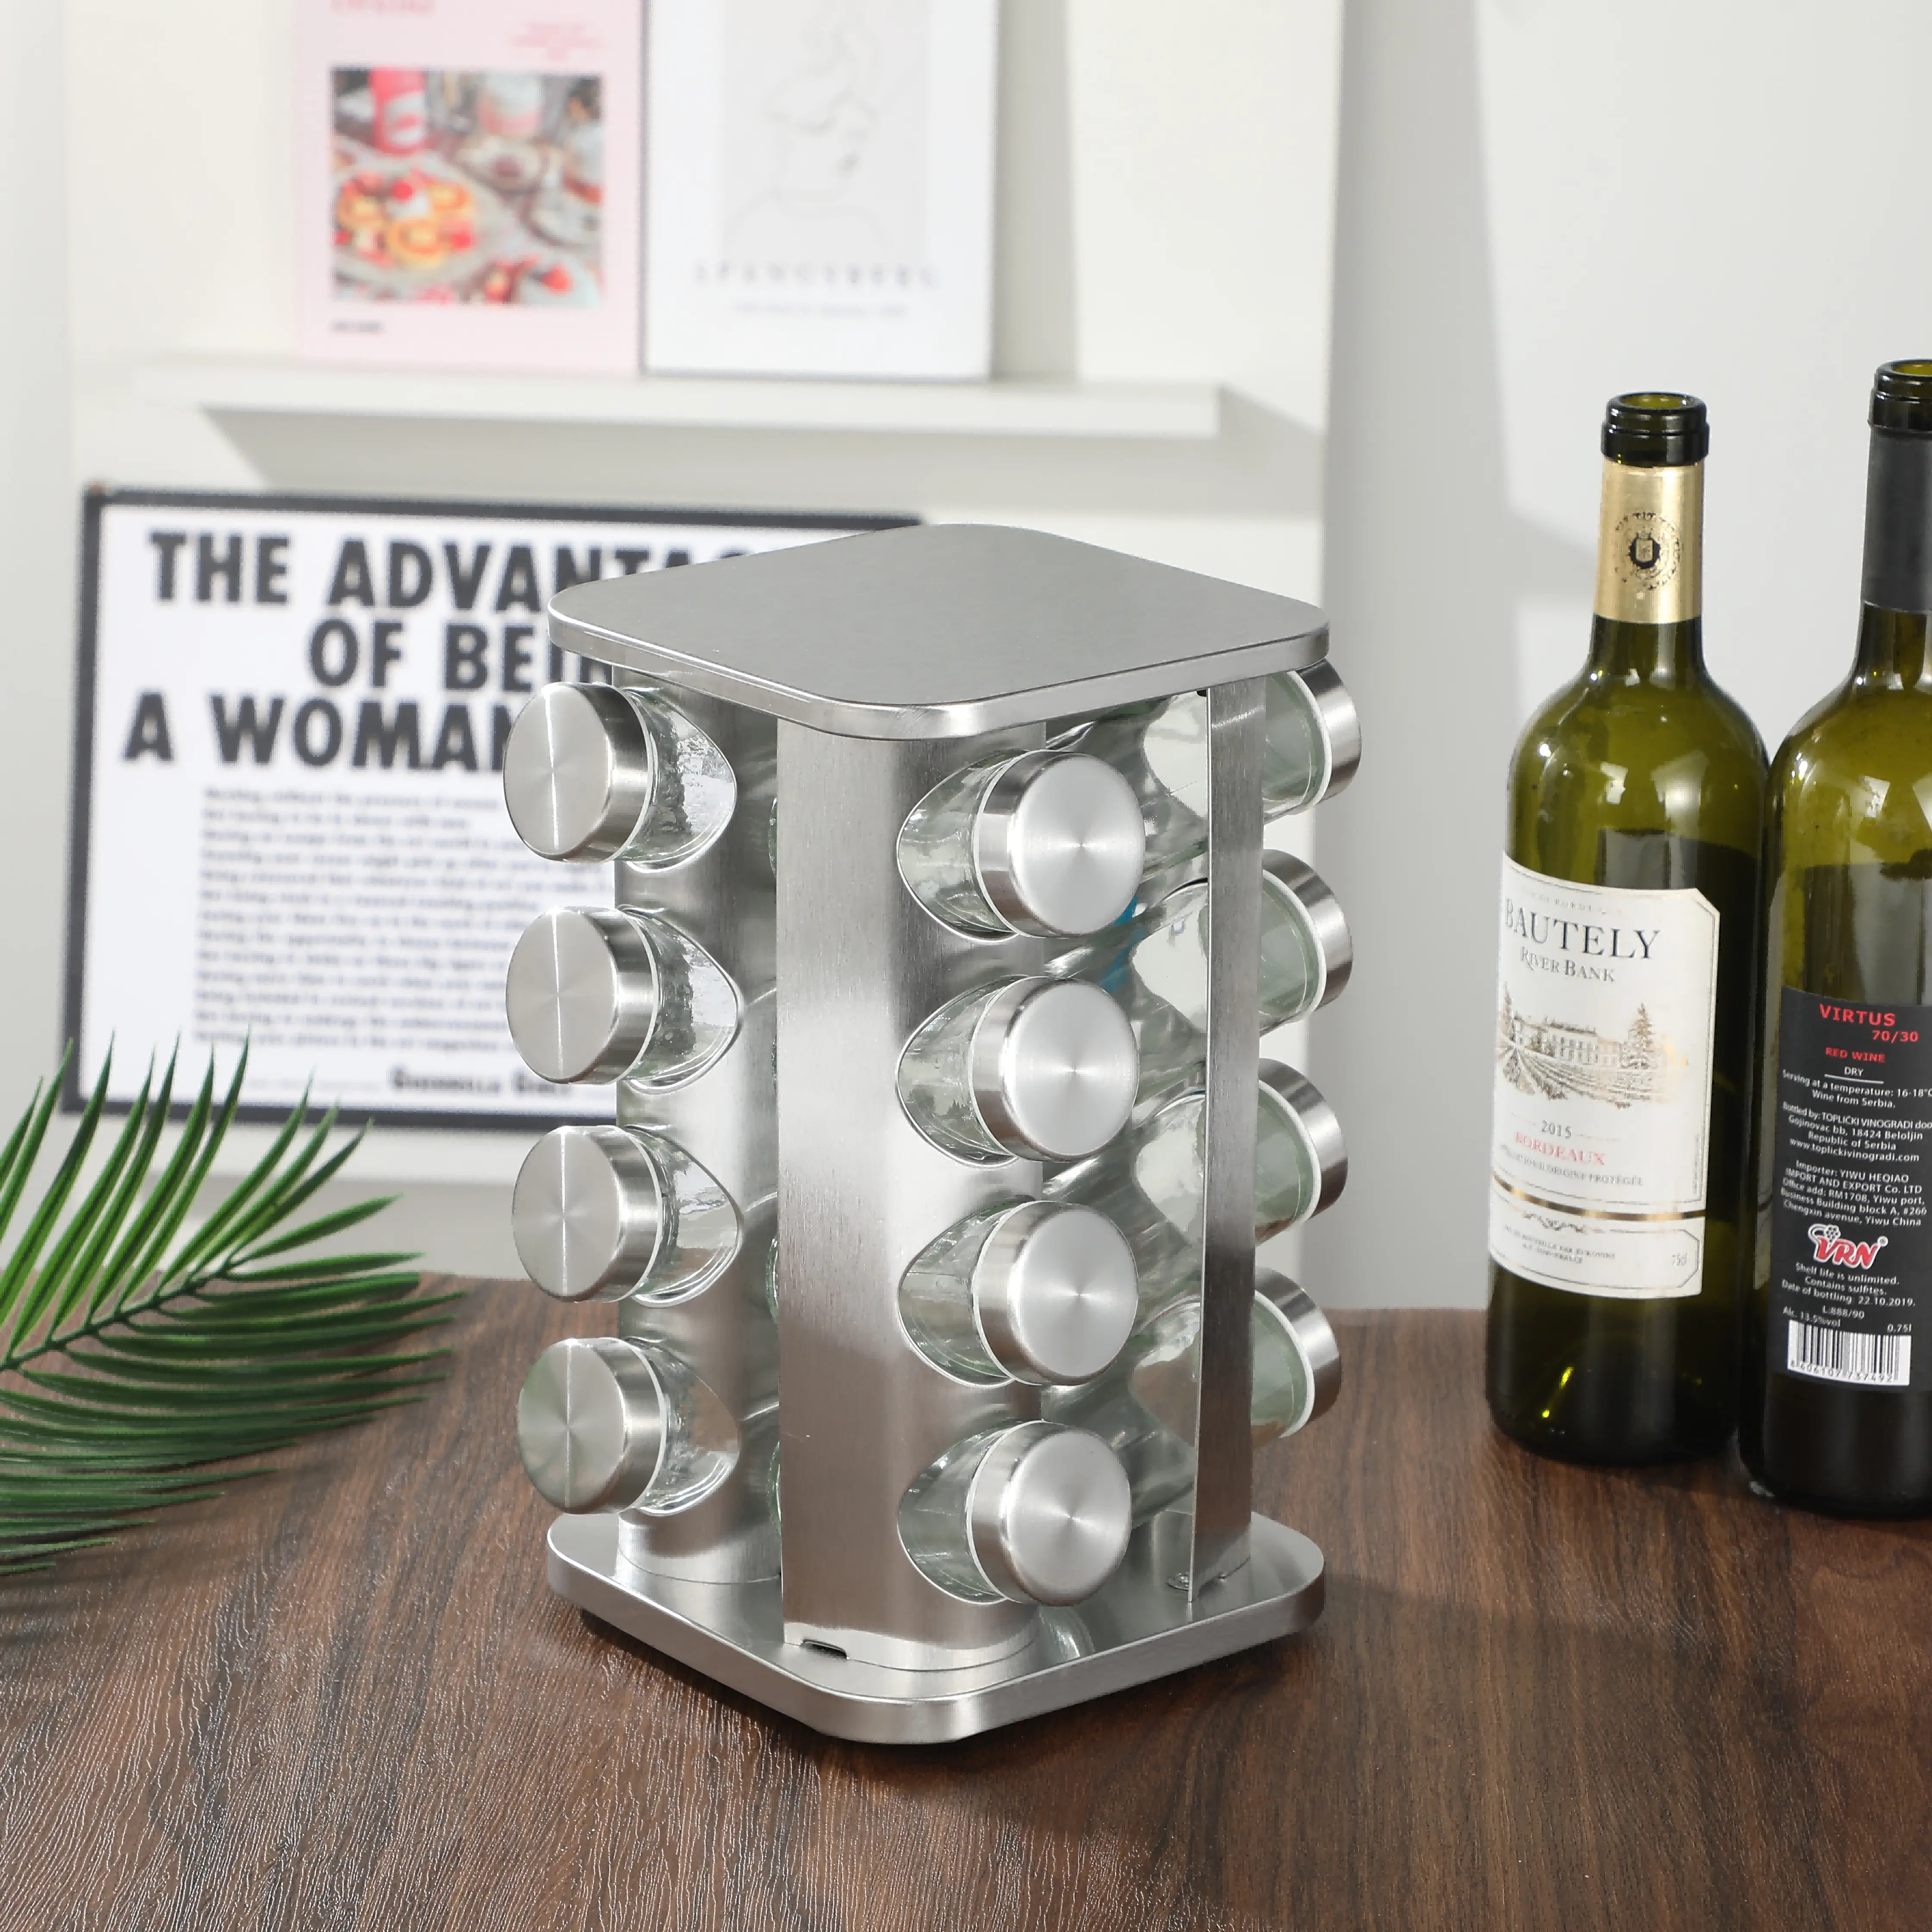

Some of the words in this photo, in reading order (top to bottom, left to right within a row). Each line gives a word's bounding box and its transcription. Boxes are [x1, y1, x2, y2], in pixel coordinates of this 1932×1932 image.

[149, 530, 290, 605] THE
[310, 618, 403, 687] OF
[124, 692, 172, 762] A
[1506, 898, 1661, 959] BAUTELY
[1565, 958, 1616, 982] BANK
[1819, 1002, 1896, 1027] VIRTUS
[1872, 1029, 1919, 1044] 70/30
[1825, 1047, 1848, 1059] RED
[1852, 1051, 1885, 1063] WINE
[1782, 1069, 1810, 1088] Serving
[1812, 1079, 1820, 1088] at
[1831, 1082, 1894, 1098] temperature:
[1844, 1066, 1864, 1077] DRY
[1811, 1088, 1835, 1102] Wine
[1836, 1094, 1859, 1106] from
[1861, 1098, 1896, 1109] Serbia.
[1782, 1101, 1808, 1117] Bottled
[1808, 1108, 1821, 1121] by:
[1861, 1117, 1913, 1130] VINOGRADI
[1541, 1120, 1572, 1139] 2015
[1788, 1114, 1831, 1133] Gojinovac
[1833, 1124, 1848, 1137] bb,
[1852, 1128, 1882, 1139] 18424
[1885, 1130, 1923, 1143] Beloljin
[1808, 1130, 1848, 1147] Republic
[1851, 1138, 1862, 1148] of
[1864, 1140, 1897, 1151] Serbia
[1790, 1138, 1919, 1163] www.toplickivinogradi.com
[1785, 1167, 1818, 1183] IMPORT
[1819, 1176, 1840, 1188] AND
[1842, 1180, 1882, 1193] EXPORT
[1904, 1185, 1923, 1195] LTD
[1796, 1159, 1838, 1177] Importer:
[1839, 1168, 1866, 1182] YIWU
[1780, 1186, 1814, 1205] Business
[1816, 1197, 1856, 1214] Building
[1859, 1204, 1887, 1215] block
[1782, 1177, 1805, 1192] Office
[1872, 1194, 1898, 1204] Yiwu
[1901, 1196, 1925, 1207] port,
[1824, 1211, 1863, 1225] avenue,
[1865, 1215, 1890, 1226] Yiwu
[1892, 1217, 1922, 1227] China
[1795, 1261, 1817, 1275] Shelf
[1819, 1267, 1835, 1279] life
[1837, 1271, 1845, 1281] is
[1781, 1278, 1800, 1292] Date
[1802, 1286, 1812, 1295] of
[1804, 1276, 1846, 1292] Contains
